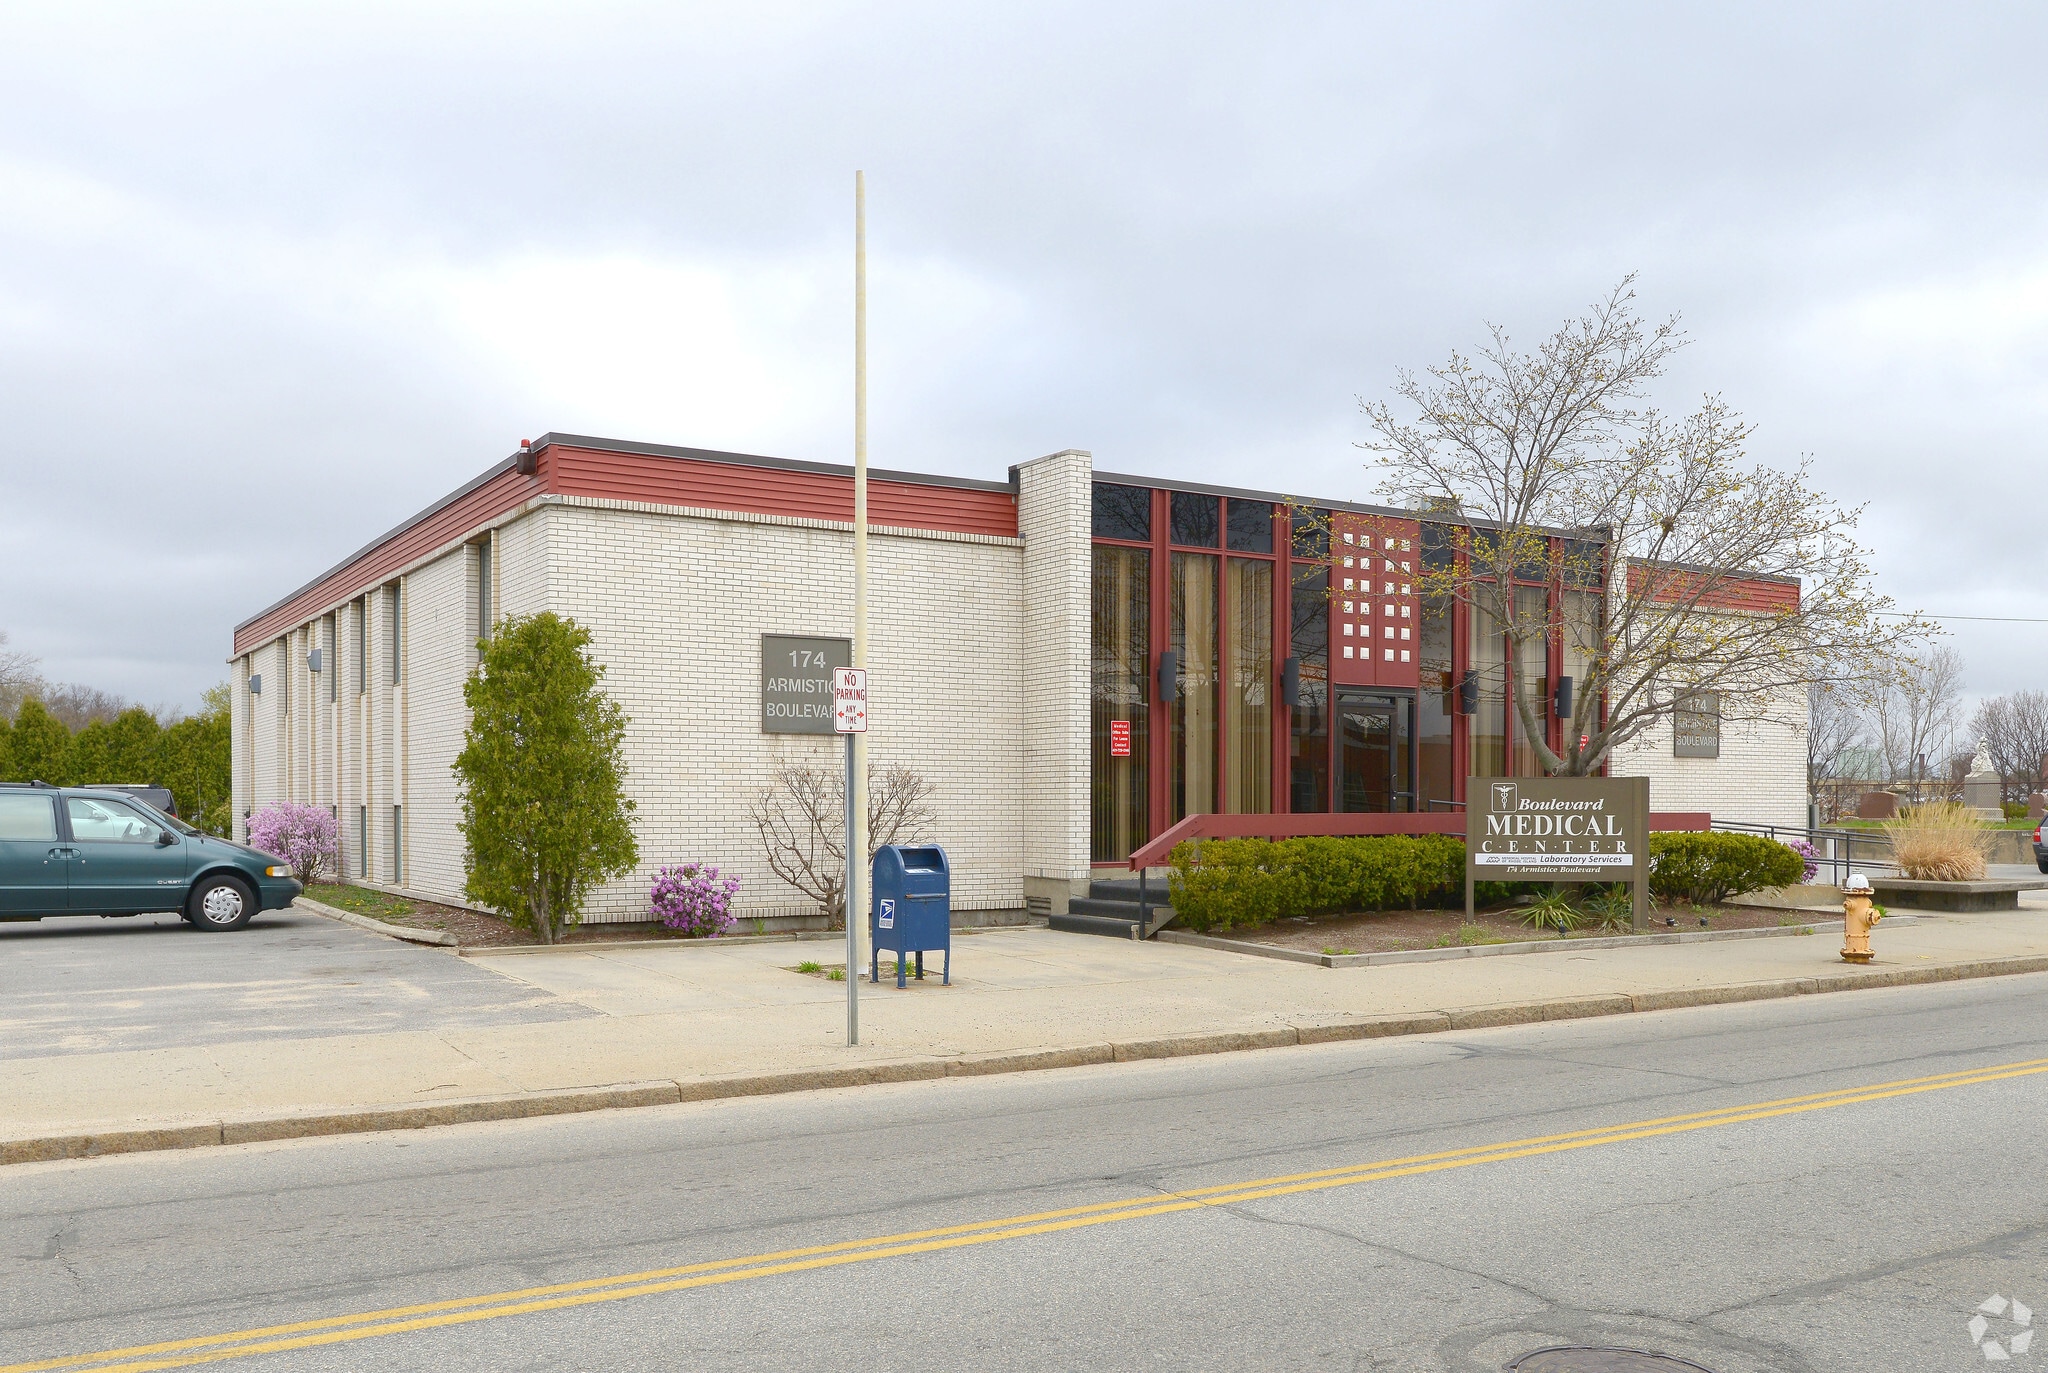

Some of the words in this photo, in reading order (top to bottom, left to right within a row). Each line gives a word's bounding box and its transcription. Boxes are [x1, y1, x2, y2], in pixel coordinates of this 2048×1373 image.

[789, 650, 826, 668] 174
[766, 678, 834, 693] ARMISTIC
[844, 674, 857, 686] NO
[836, 688, 865, 701] PARKING
[845, 705, 857, 713] ANY
[1688, 699, 1708, 711] 174
[845, 716, 857, 724] TIME
[1676, 735, 1718, 746] BOULEVARD
[1518, 798, 1605, 811] Boulevard
[1485, 814, 1623, 836] MEDICAL
[1540, 855, 1587, 865] Laboratory
[1588, 855, 1623, 863] Services
